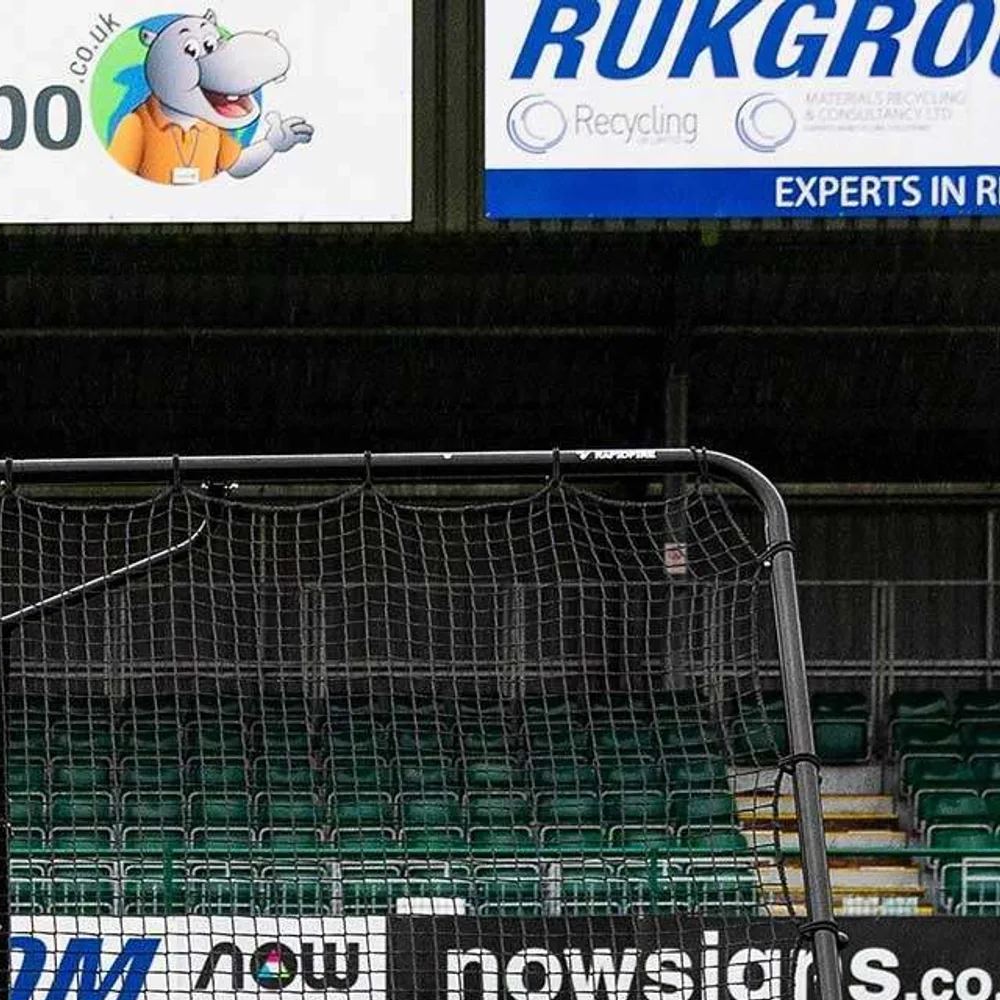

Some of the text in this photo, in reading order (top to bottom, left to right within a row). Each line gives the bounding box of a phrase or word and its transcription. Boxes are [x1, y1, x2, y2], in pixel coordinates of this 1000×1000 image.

[69, 13, 121, 84] .co.uk
[510, 0, 1000, 80] RUKGRO
[575, 104, 698, 144] Recycling
[775, 174, 1000, 208] EXPERTS IN R
[194, 941, 360, 990] now
